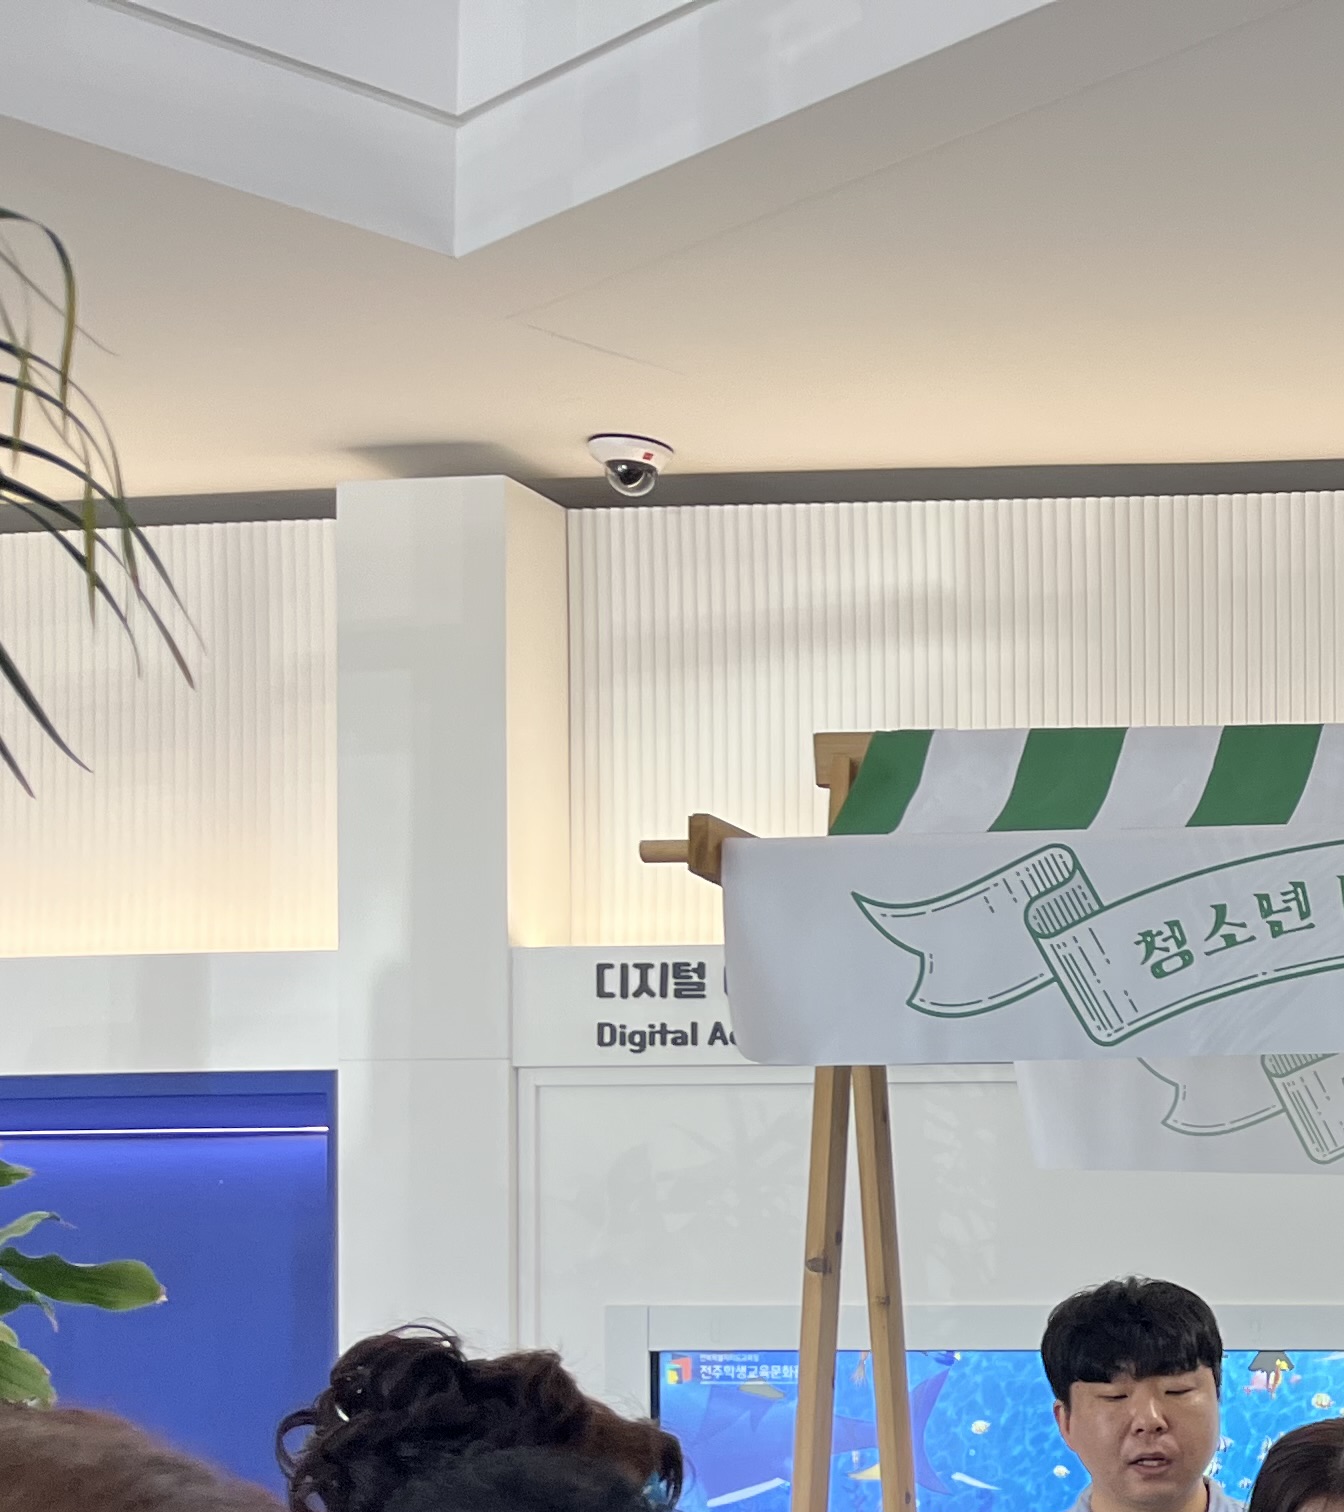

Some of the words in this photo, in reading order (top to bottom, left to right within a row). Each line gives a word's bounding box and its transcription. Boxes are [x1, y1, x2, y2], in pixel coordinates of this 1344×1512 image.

[1134, 880, 1316, 980] 청소년
[595, 960, 707, 1000] 디지털
[597, 1021, 699, 1054] Digital
